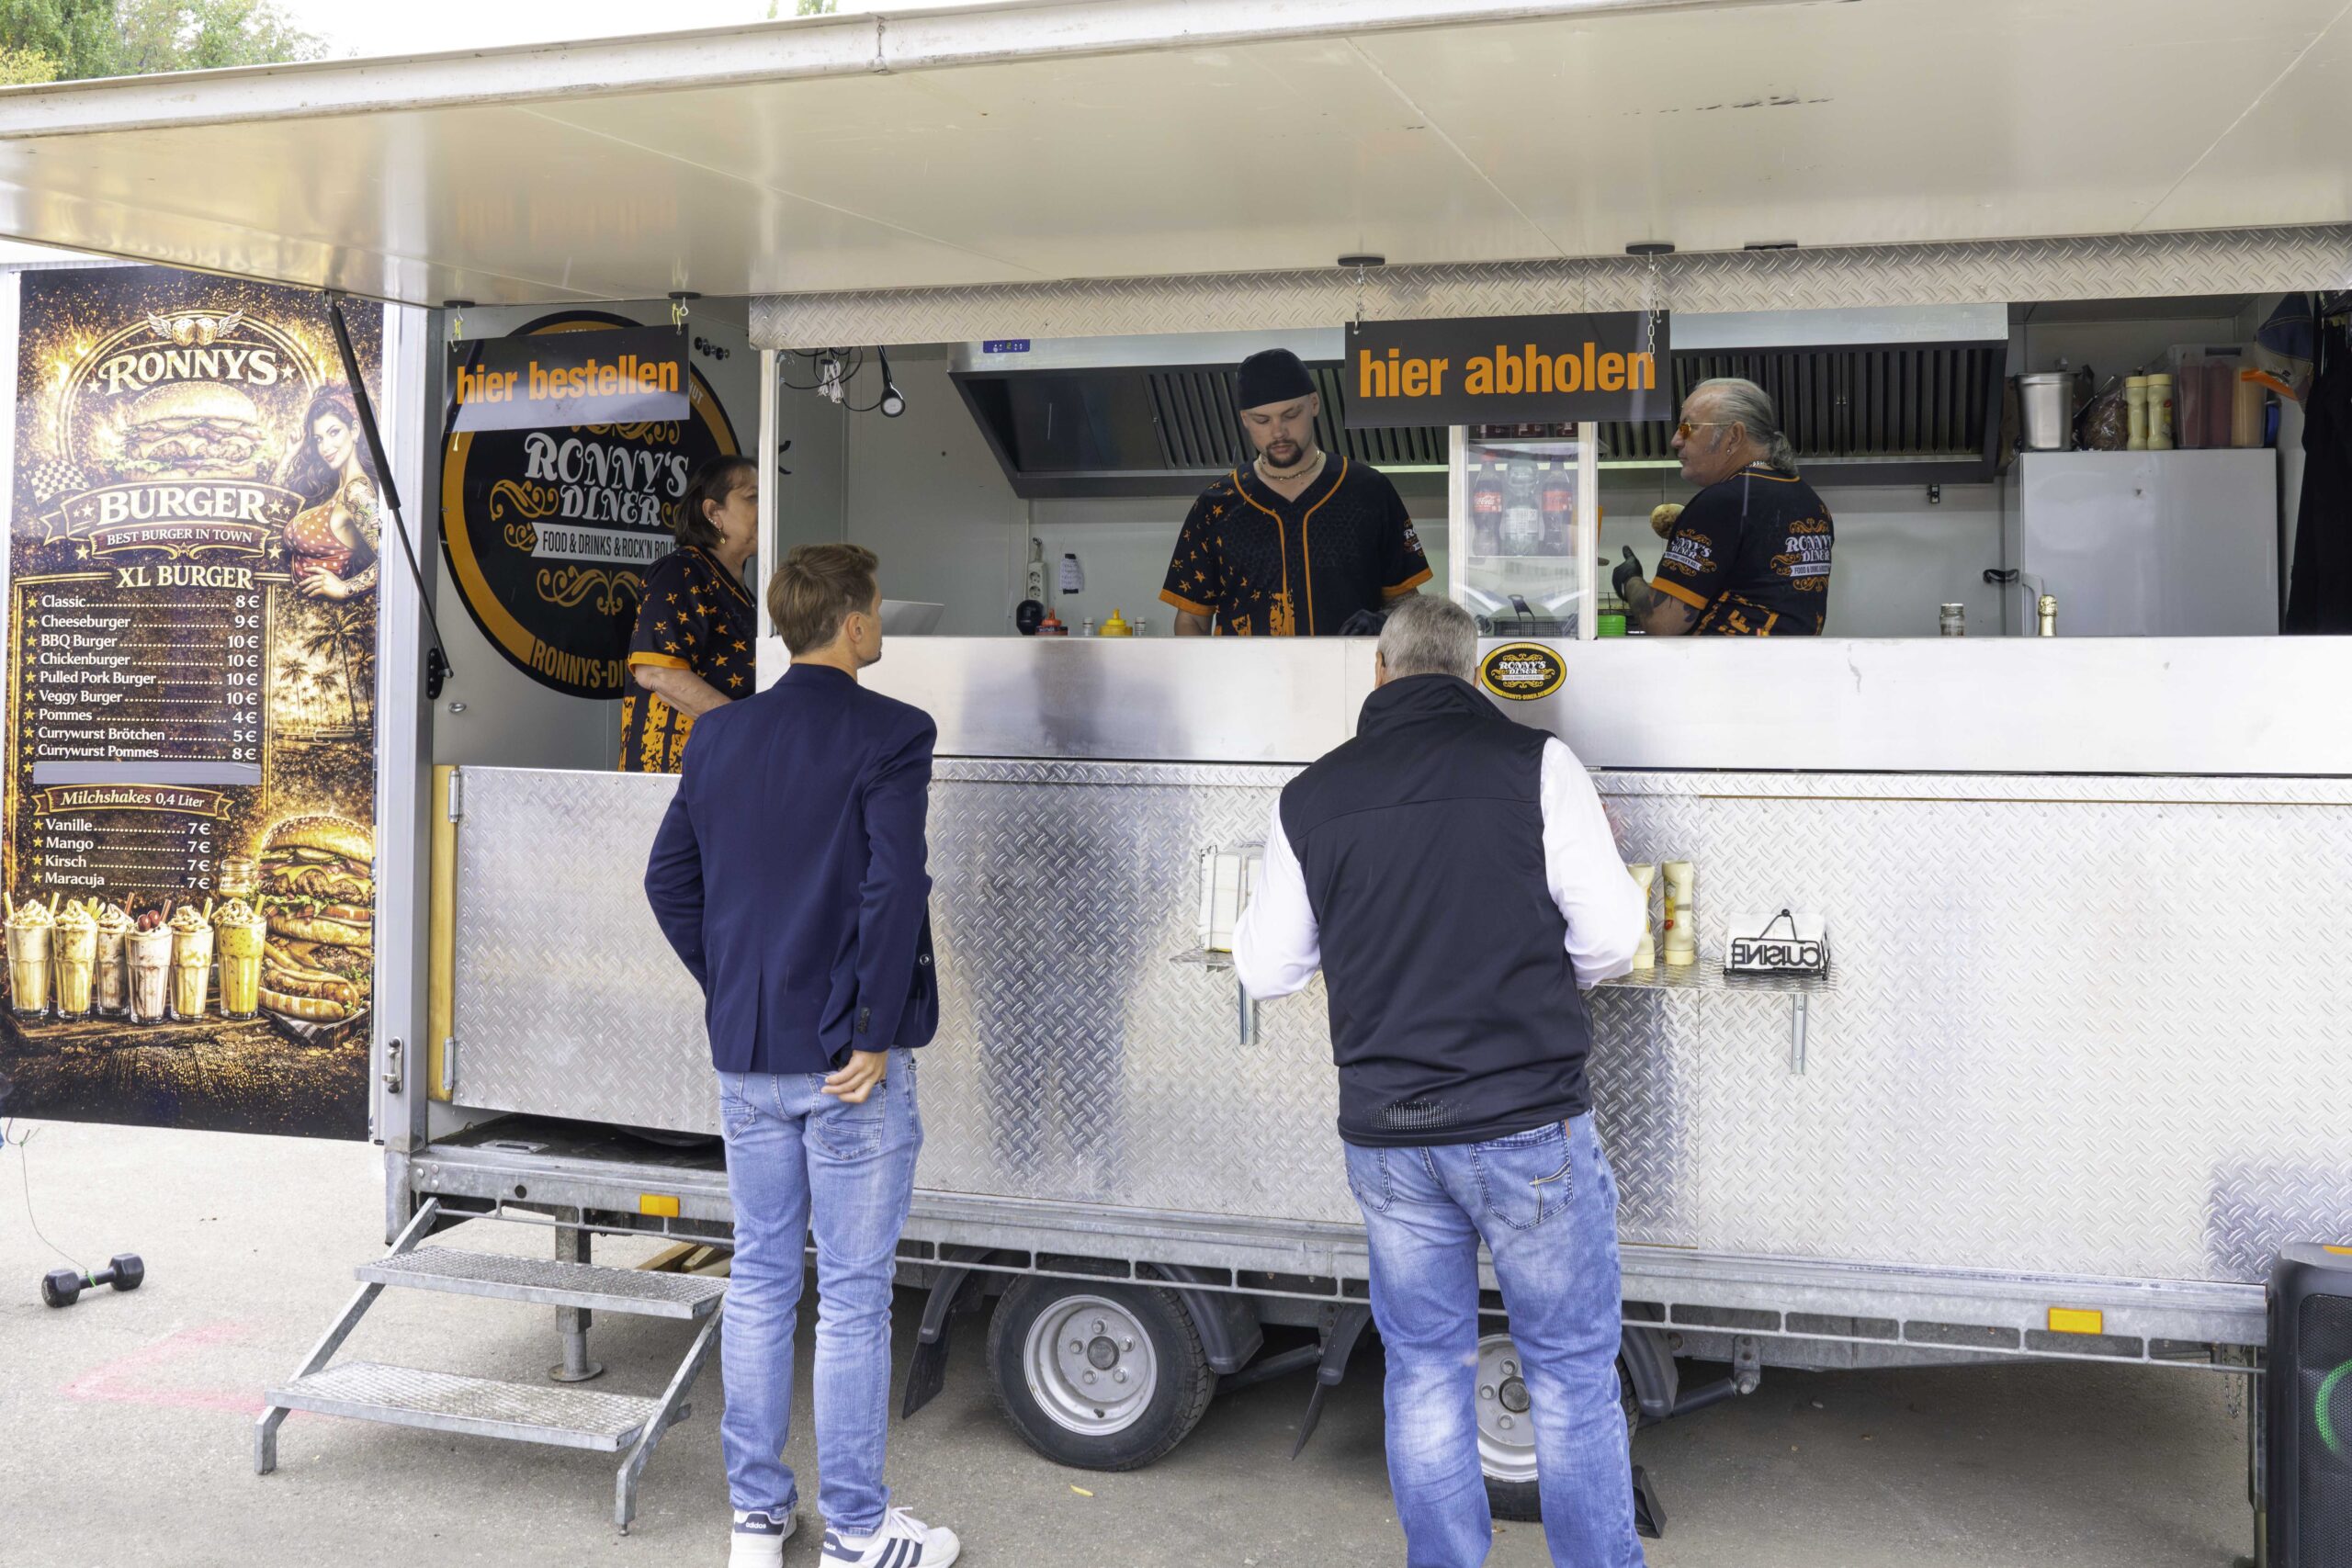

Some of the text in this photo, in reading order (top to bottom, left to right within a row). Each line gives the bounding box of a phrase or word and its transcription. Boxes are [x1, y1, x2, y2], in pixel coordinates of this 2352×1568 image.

[98, 349, 278, 396] RONNYS
[1360, 343, 1656, 398] hier abholen
[456, 355, 679, 405] hier bestellen
[524, 432, 689, 499] RONNY'S
[96, 487, 270, 525] BURGER
[560, 484, 661, 527] DINER
[107, 529, 253, 546] BEST BURGER IN TOWN
[543, 530, 567, 553] FOOD
[570, 535, 577, 554] &
[579, 535, 611, 556] DRINKS
[1785, 535, 1832, 553] RONNY
[117, 566, 254, 590] XL BURGER
[41, 595, 86, 608] Classic
[41, 615, 130, 630] Cheeseburger
[40, 634, 71, 649] BBQ
[73, 635, 118, 650] Burger
[40, 652, 130, 669] Chickenburger
[531, 638, 625, 689] RONNYS-DI
[1498, 660, 1545, 670] RONNY'S
[40, 671, 78, 683] Pulled
[81, 671, 110, 683] Pork
[113, 672, 156, 687] Burger
[40, 690, 77, 705] Veggy
[81, 691, 123, 705] Burger
[39, 708, 93, 721] Pommes
[38, 727, 106, 741] Currywurst
[108, 728, 165, 741] Brötchen
[38, 744, 106, 759] Currywurst
[108, 745, 160, 759] Pommes
[60, 789, 205, 808] Milchshakes 0,4 Liter
[45, 818, 93, 831] Vanille
[46, 837, 94, 853] Mango
[45, 854, 87, 868] Kirsch
[44, 872, 106, 887] Maracuja
[745, 1521, 767, 1529] adidas
